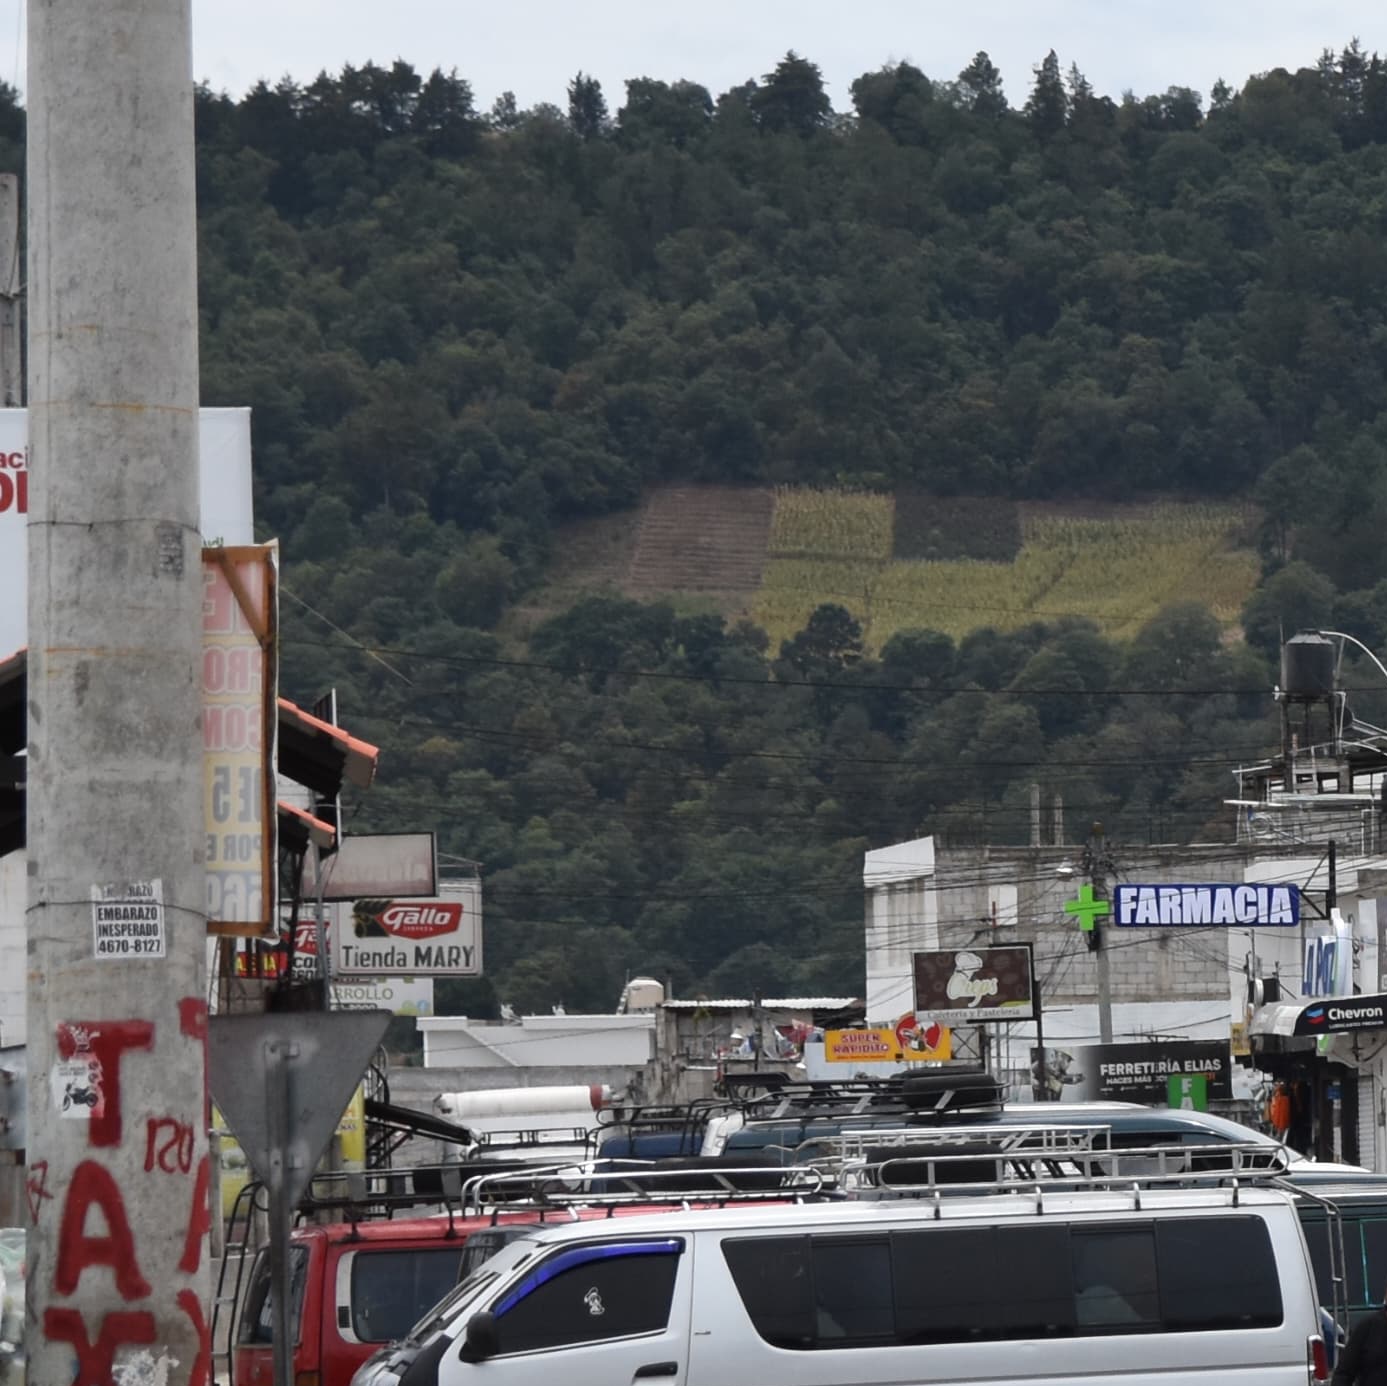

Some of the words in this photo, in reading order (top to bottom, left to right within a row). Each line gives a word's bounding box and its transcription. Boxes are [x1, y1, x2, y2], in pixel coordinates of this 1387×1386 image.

[1119, 886, 1293, 925] FARMACIA
[97, 907, 158, 921] EMBARAZO
[383, 906, 451, 931] Gallo
[98, 923, 159, 937] INESPERADO
[99, 939, 161, 953] 4670-8127
[342, 945, 408, 968] Tienda
[414, 945, 476, 968] MARY
[1328, 1007, 1384, 1021] Chevron
[841, 1033, 881, 1043] SUPER
[1184, 1058, 1222, 1072] ELIAS
